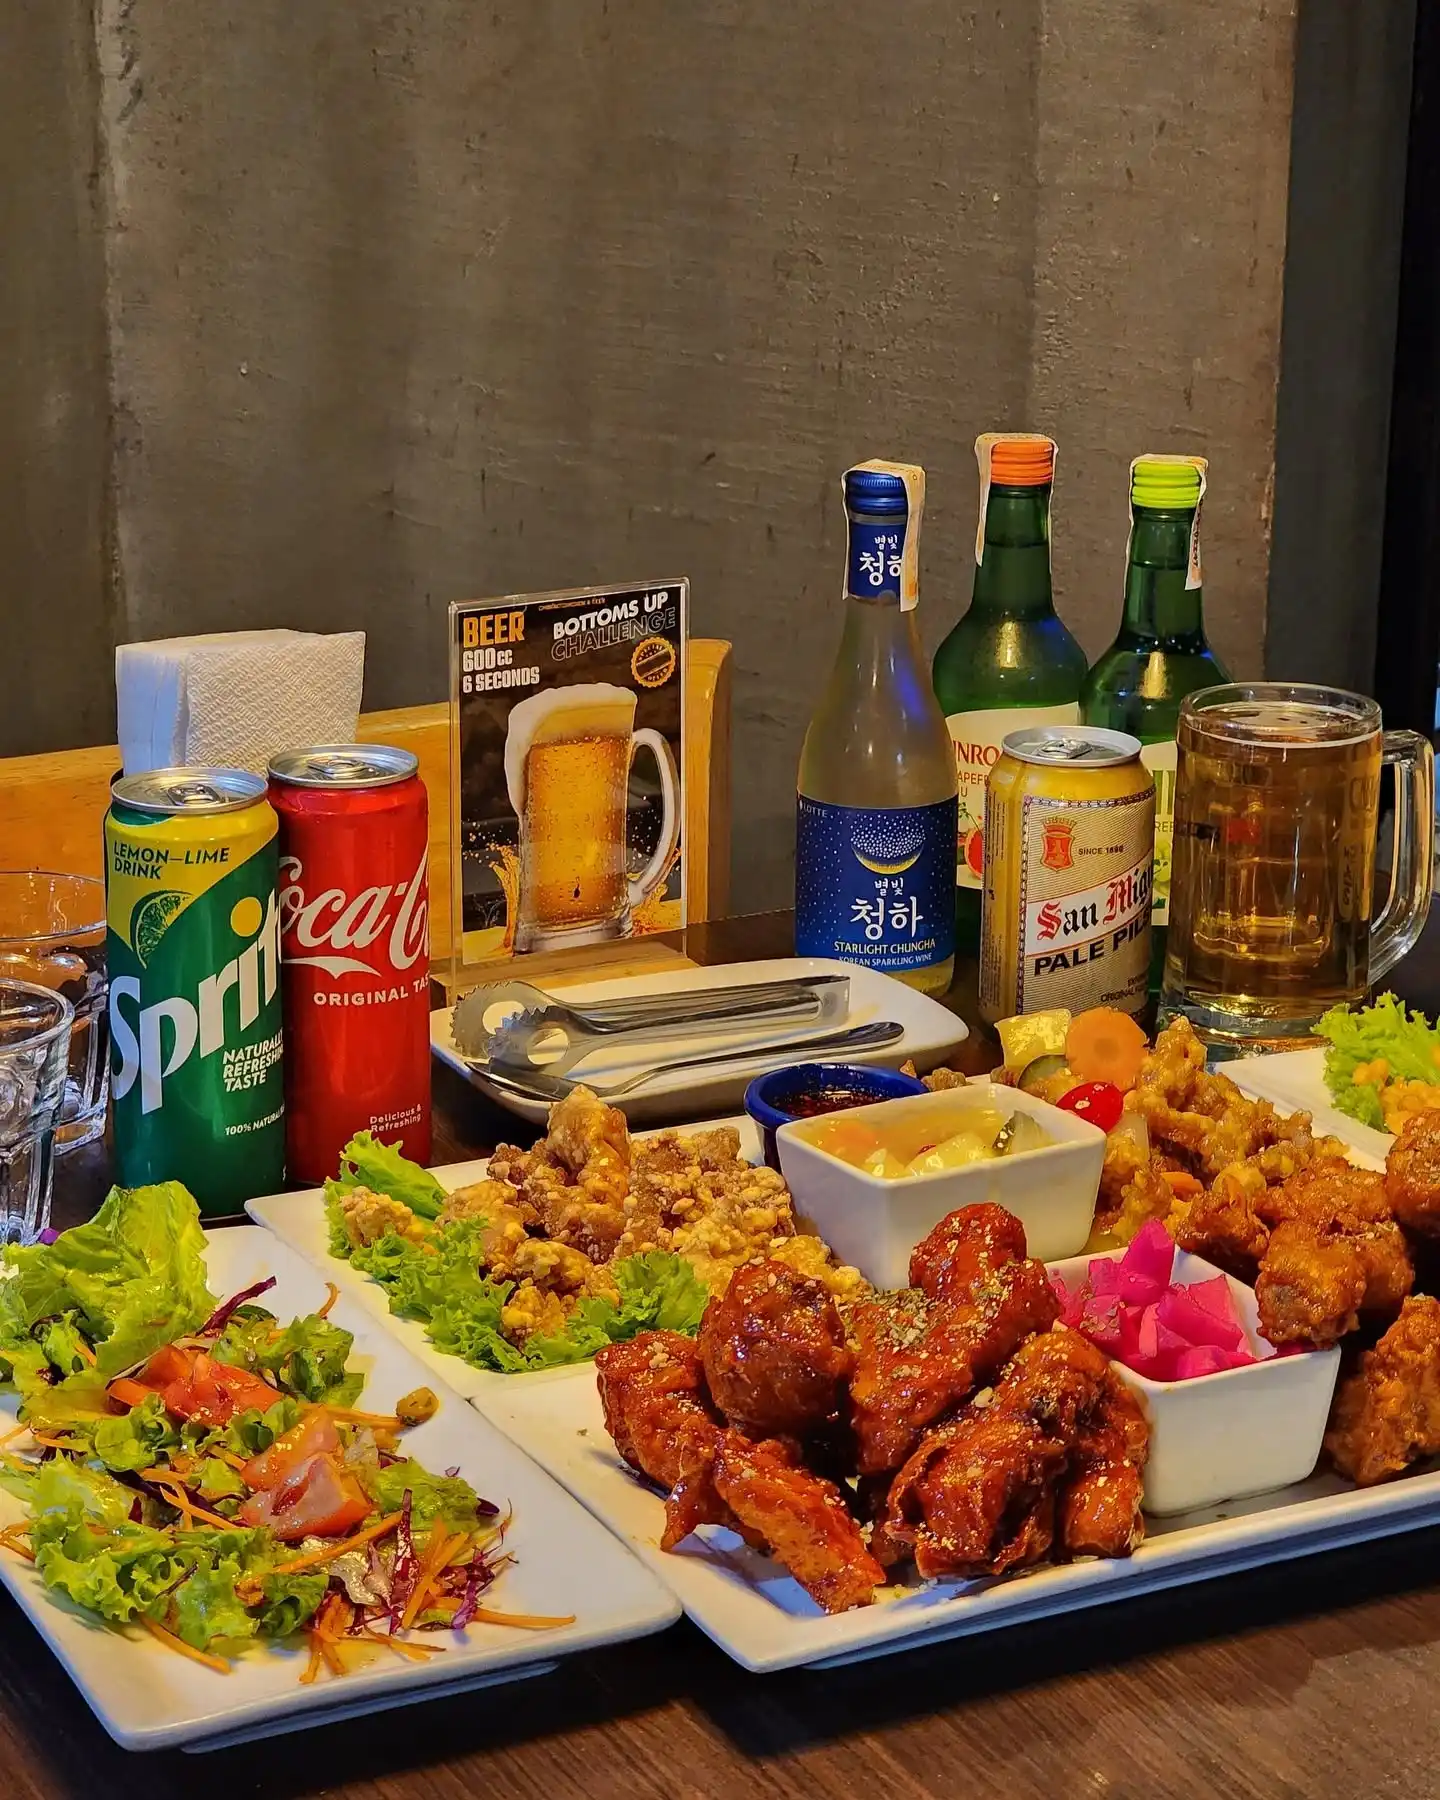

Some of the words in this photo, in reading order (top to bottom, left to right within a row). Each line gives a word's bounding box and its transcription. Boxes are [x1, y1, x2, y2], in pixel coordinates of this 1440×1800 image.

[874, 534, 898, 550] 별빛
[553, 601, 640, 640] BOTTOMS
[644, 591, 669, 613] UP
[463, 611, 525, 648] BEER
[551, 607, 677, 662] CHALLENGE
[462, 648, 513, 672] 600cc
[462, 676, 473, 694] 6
[475, 666, 541, 691] SECONDS
[803, 801, 828, 818] LOTTE
[1078, 847, 1103, 856] SINCE
[114, 857, 163, 880] DRINK
[874, 877, 904, 896] 별빛
[1037, 900, 1099, 941] San
[1102, 865, 1152, 925] Mig
[850, 895, 924, 941] 청하
[833, 940, 889, 955] STARLIGHT
[890, 937, 936, 955] CHUNGHA
[1034, 938, 1105, 977] PALE
[871, 955, 915, 967] SPARKLING
[915, 952, 933, 964] WINE
[313, 984, 409, 1007] ORIGINAL
[412, 970, 430, 994] TAS
[109, 887, 283, 1116] Sprit
[223, 1068, 267, 1093] TASTE
[369, 1107, 415, 1125] Delicious
[370, 1113, 421, 1132] Refreshing
[225, 1123, 252, 1136] 100%
